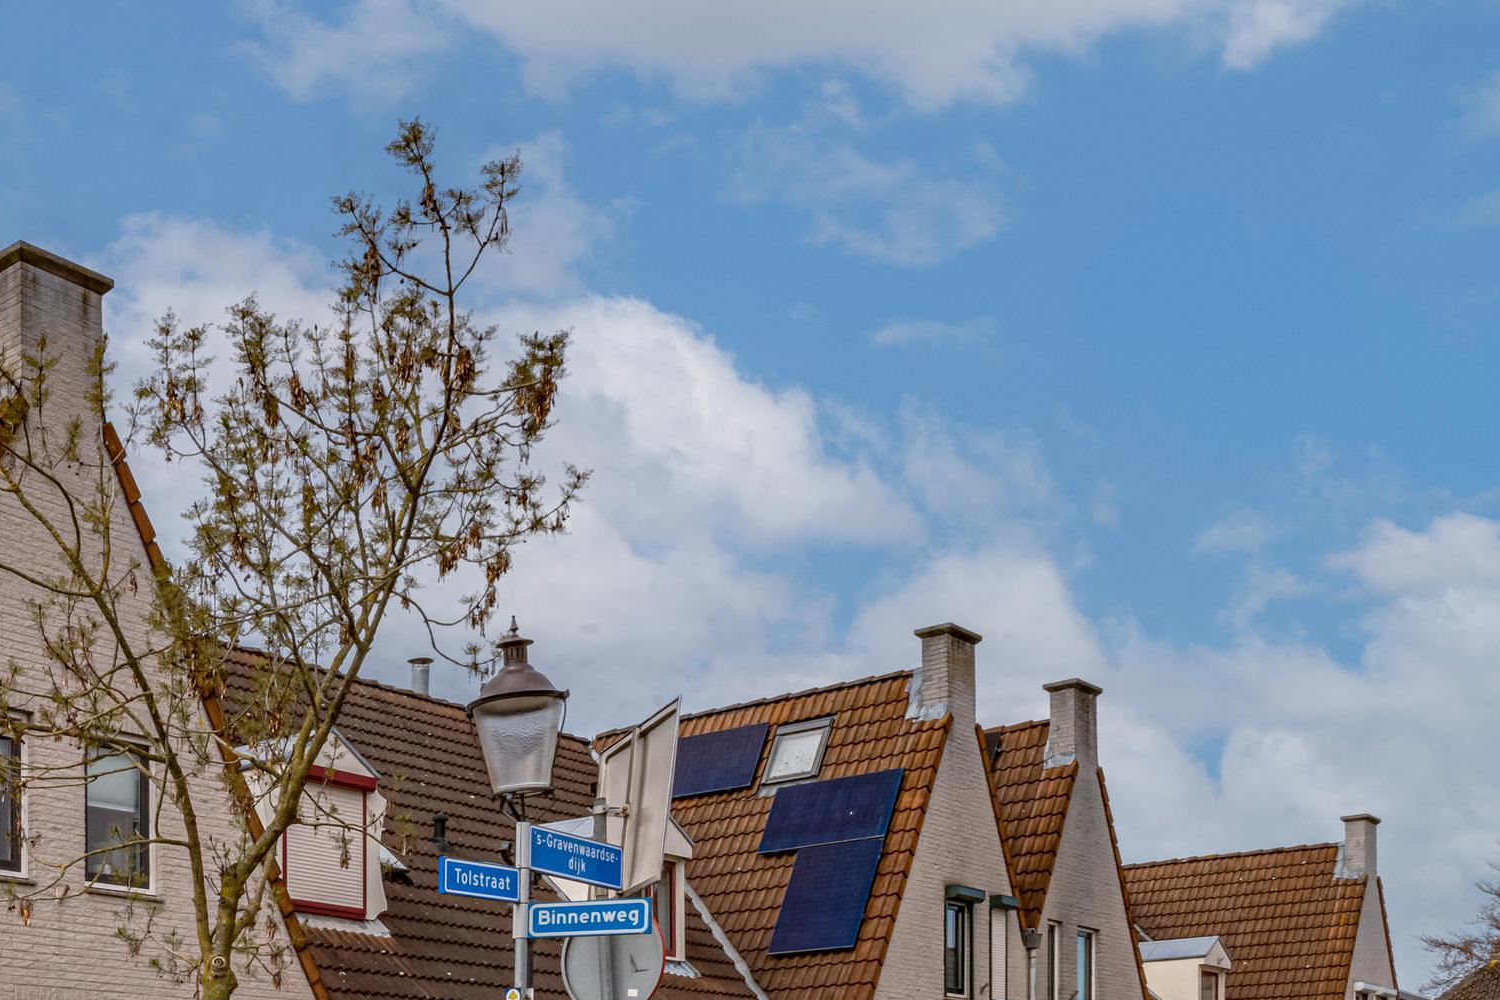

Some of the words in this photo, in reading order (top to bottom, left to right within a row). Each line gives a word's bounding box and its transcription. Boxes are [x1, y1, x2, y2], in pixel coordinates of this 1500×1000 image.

[568, 857, 586, 875] dijk
[454, 868, 511, 891] Tolstraat
[538, 909, 640, 926] Binnenweg
